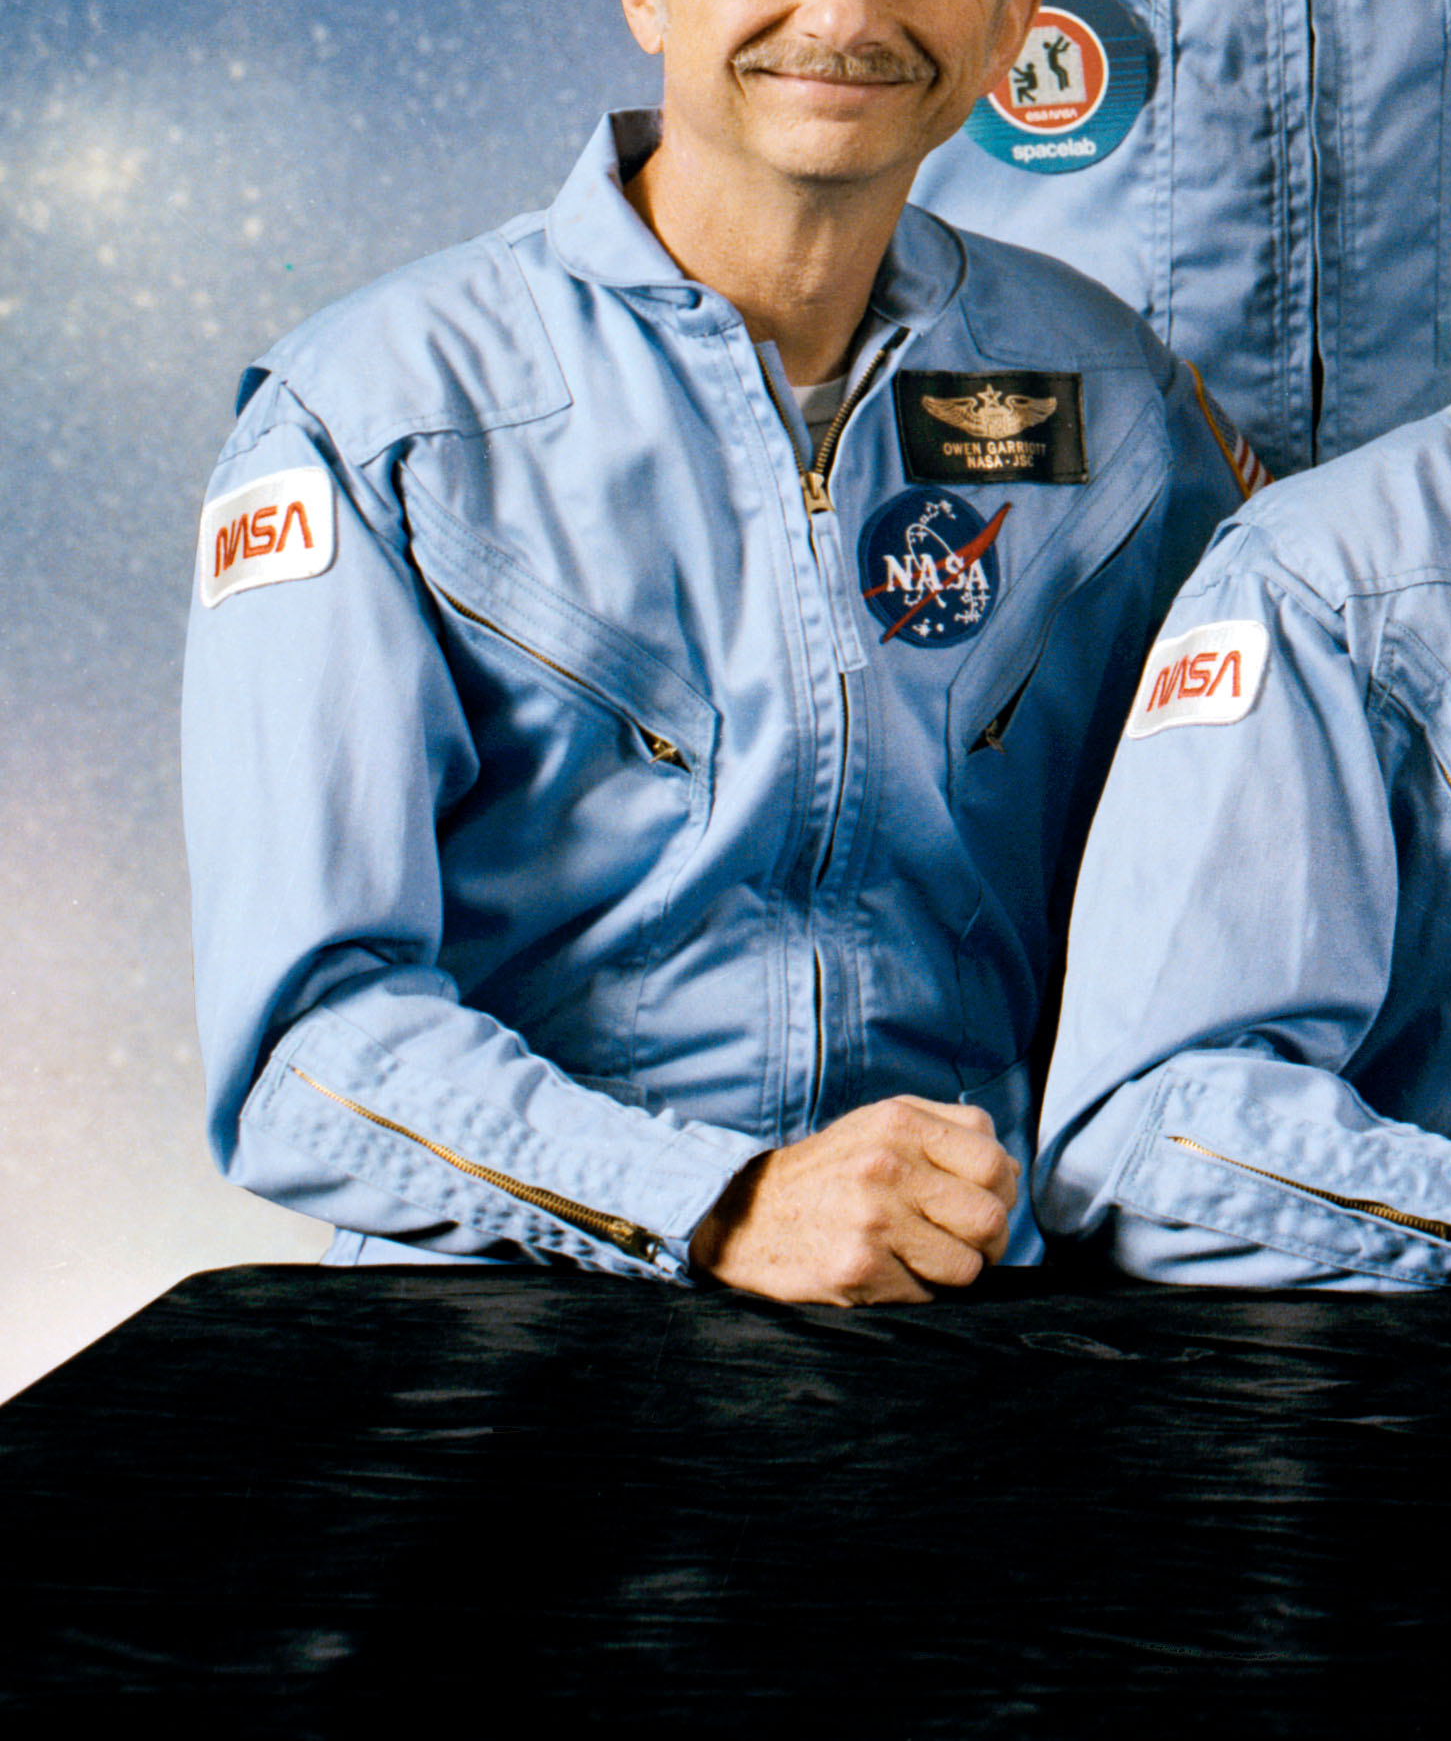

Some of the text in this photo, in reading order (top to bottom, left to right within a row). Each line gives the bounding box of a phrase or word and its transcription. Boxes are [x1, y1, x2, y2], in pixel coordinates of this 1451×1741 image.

[1012, 138, 1096, 163] spacelab
[943, 440, 1046, 456] OWEN GARRIOTT
[967, 455, 1003, 469] NASA
[214, 500, 314, 578] NASA
[883, 553, 989, 592] NASA
[1146, 650, 1242, 712] NASA
